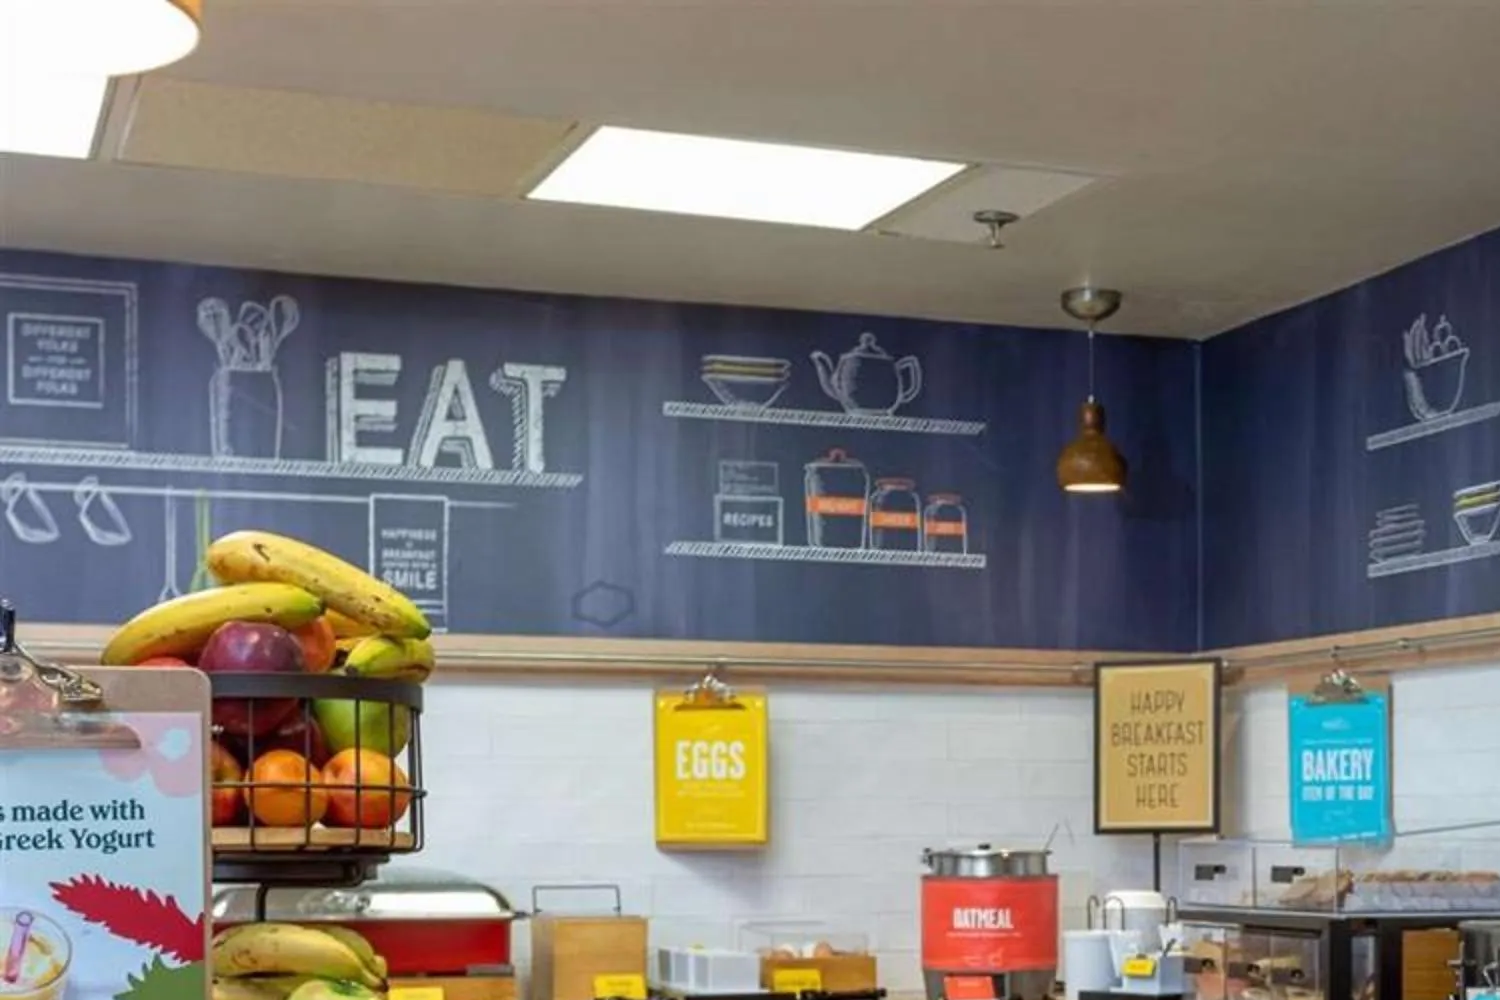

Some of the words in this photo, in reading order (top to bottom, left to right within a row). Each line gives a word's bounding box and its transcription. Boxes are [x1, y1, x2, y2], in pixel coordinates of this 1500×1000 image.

[327, 352, 567, 473] EAT
[723, 511, 774, 529] RECIPES
[383, 569, 437, 590] SMILE
[1130, 689, 1186, 714] HAPPY
[1110, 720, 1205, 747] BREAKFAST
[675, 739, 747, 781] EGGS
[1126, 752, 1189, 777] STARTS
[1302, 748, 1374, 782] BAKERY
[1136, 782, 1181, 809] HERE
[11, 799, 85, 822] made
[89, 798, 146, 821] with
[69, 827, 156, 854] Yogurt
[953, 907, 1014, 929] OATMEAL
